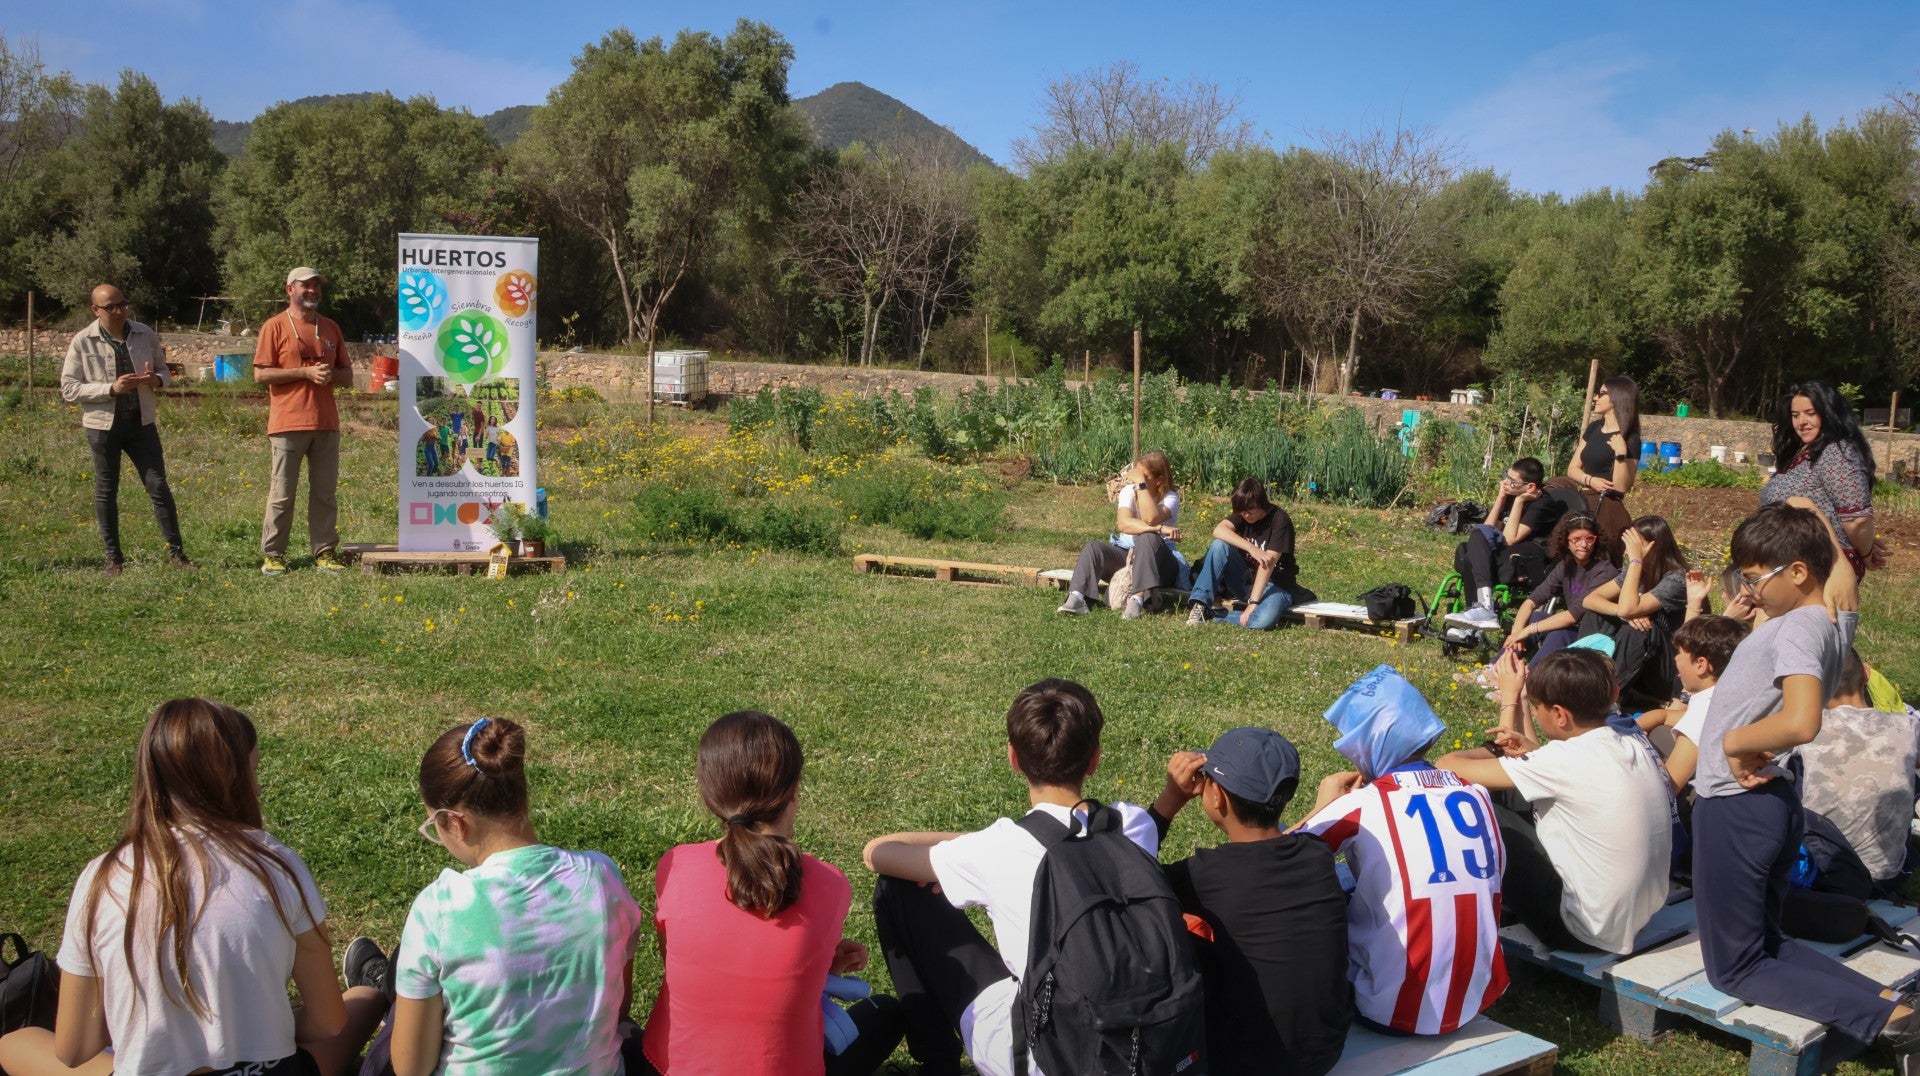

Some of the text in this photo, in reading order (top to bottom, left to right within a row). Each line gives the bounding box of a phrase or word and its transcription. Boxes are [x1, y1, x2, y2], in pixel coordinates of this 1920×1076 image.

[402, 248, 507, 268] HUERTOS
[431, 268, 496, 276] Intergeneracionales
[451, 299, 492, 313] Siembra
[504, 317, 534, 329] Recoge
[402, 331, 433, 341] Enseña
[412, 480, 428, 488] Ven
[435, 480, 470, 488] descubrir
[427, 490, 457, 498] jugando
[1413, 769, 1463, 787] TORRES
[1405, 790, 1495, 884] 19
